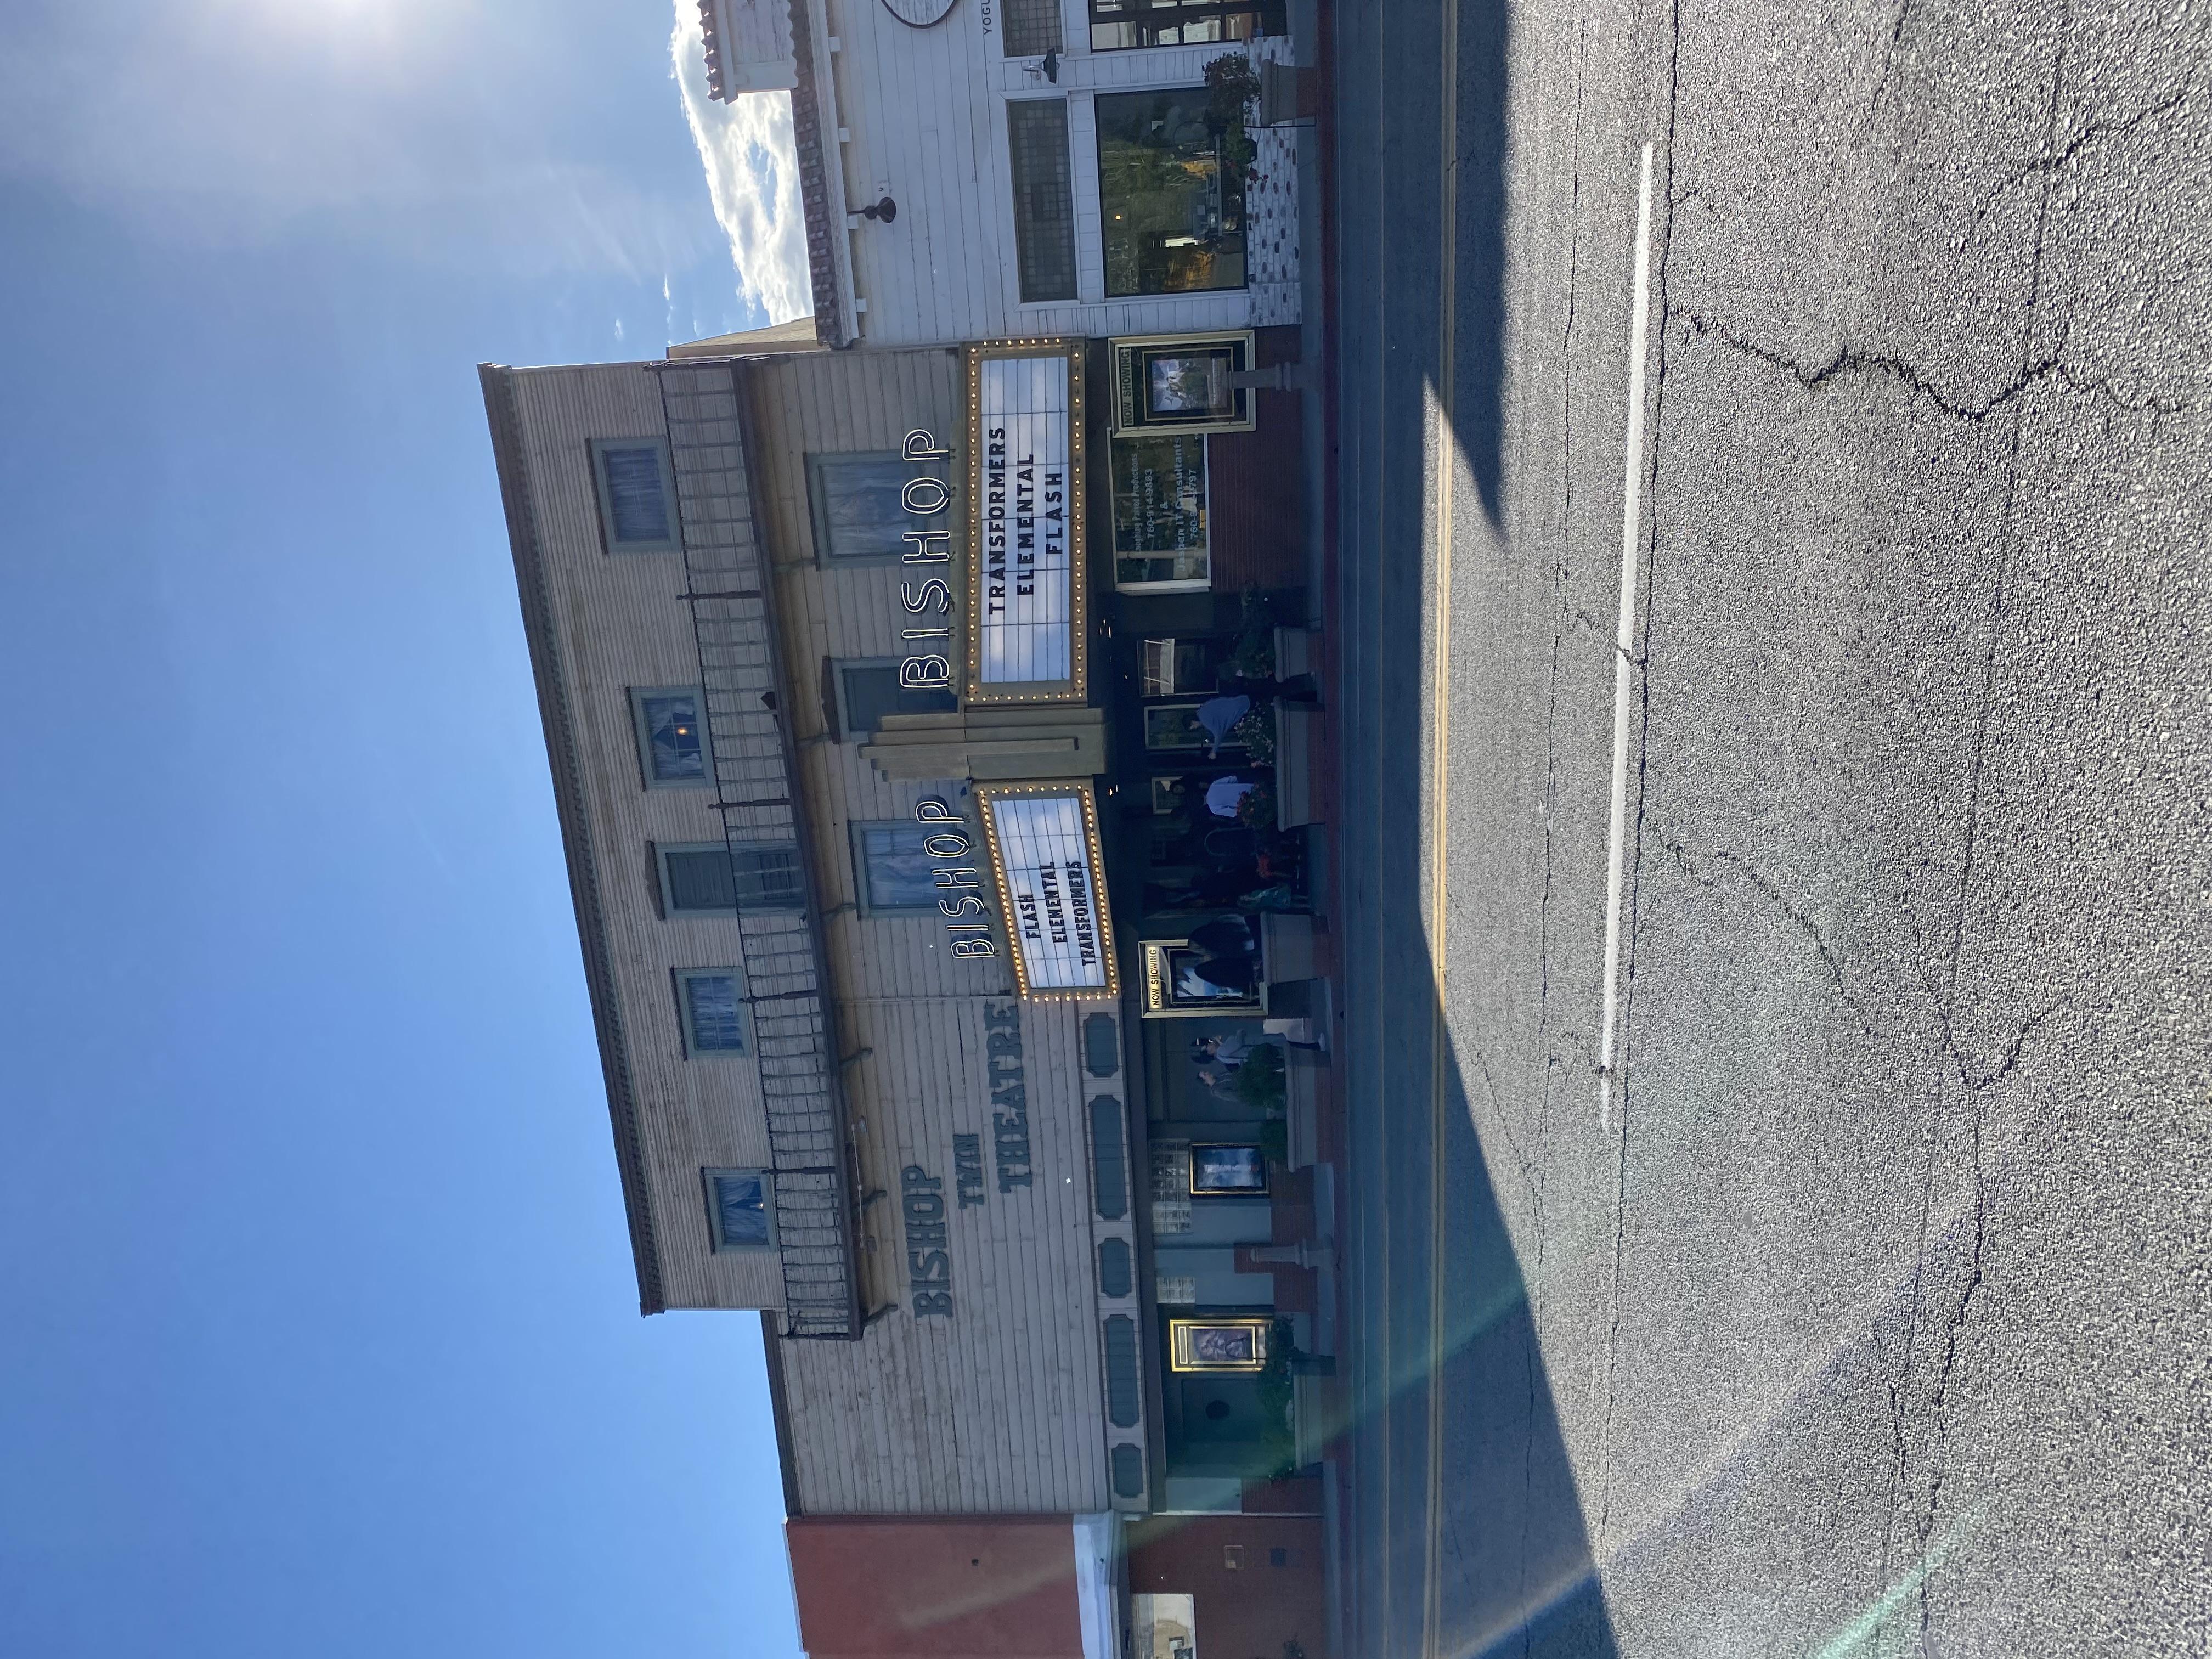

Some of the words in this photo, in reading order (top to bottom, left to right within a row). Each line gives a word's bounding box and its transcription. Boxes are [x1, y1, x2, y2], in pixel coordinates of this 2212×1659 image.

[1121, 351, 1131, 397] SHOWING
[1124, 402, 1133, 424] NOW
[1045, 472, 1063, 555] FLASH
[1173, 437, 1183, 509] Consultants
[899, 428, 950, 689] BISHOP
[988, 427, 1006, 615] TRANSFORMERS
[1016, 453, 1034, 596] ELEMENTAL
[1175, 514, 1184, 526] IT
[915, 798, 995, 958] BISHOP
[1018, 893, 1041, 939] FLASH
[1039, 861, 1068, 943] ELEMENTAL
[1065, 860, 1097, 966] TRANSFORMERS
[1149, 950, 1159, 985] SHOWING
[1151, 988, 1160, 1006] NOW
[984, 1002, 1032, 1194] THEATRE
[952, 1133, 984, 1210] TWIN
[901, 1166, 953, 1318] BISHOP
